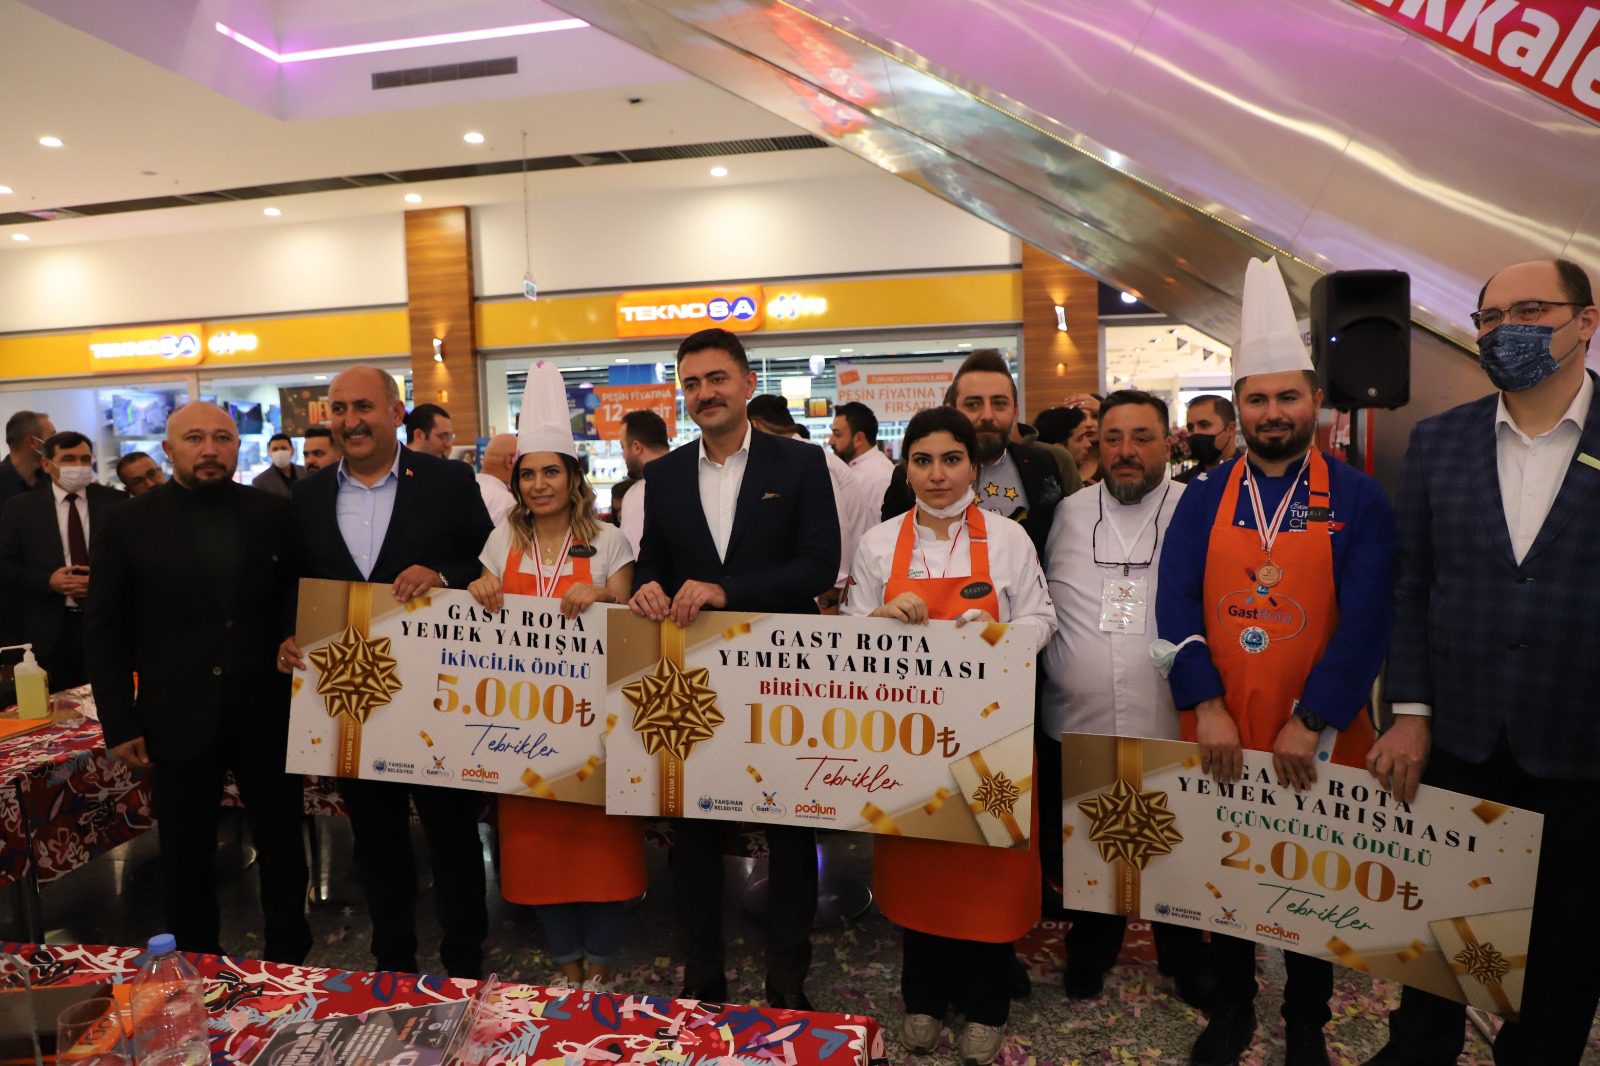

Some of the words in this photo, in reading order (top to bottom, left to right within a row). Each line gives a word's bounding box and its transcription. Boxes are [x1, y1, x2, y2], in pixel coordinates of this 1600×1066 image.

[619, 298, 756, 321] TEKNOSA
[602, 403, 623, 422] 12
[448, 604, 510, 625] GAST
[521, 610, 585, 632] ROTA
[401, 620, 482, 643] YEMEK
[495, 629, 605, 656] YARIŞMA
[771, 629, 843, 649] GAST
[856, 633, 930, 653] ROTA
[441, 648, 526, 673] İKİNCİLİK
[531, 658, 591, 680] ÖDÜLÜ
[718, 649, 812, 670] YEMEK
[826, 654, 986, 680] YARIŞMASI
[759, 677, 869, 701] BİRİNCİLİK
[875, 683, 945, 706] ÖDÜLÜ
[464, 723, 559, 760] Tebrikler
[461, 765, 499, 780] podium
[796, 755, 904, 793] Tebrikler
[795, 801, 837, 816] podium
[1328, 779, 1412, 814] ROTA
[1177, 776, 1278, 806] YEMEK
[1294, 794, 1477, 853] YARIŞMASI
[1216, 805, 1345, 846] ÜÇÜNCÜLÜK
[1352, 832, 1433, 867] ÖDÜLÜ
[1258, 882, 1375, 931] Tebrikler
[1255, 922, 1300, 940] podium
